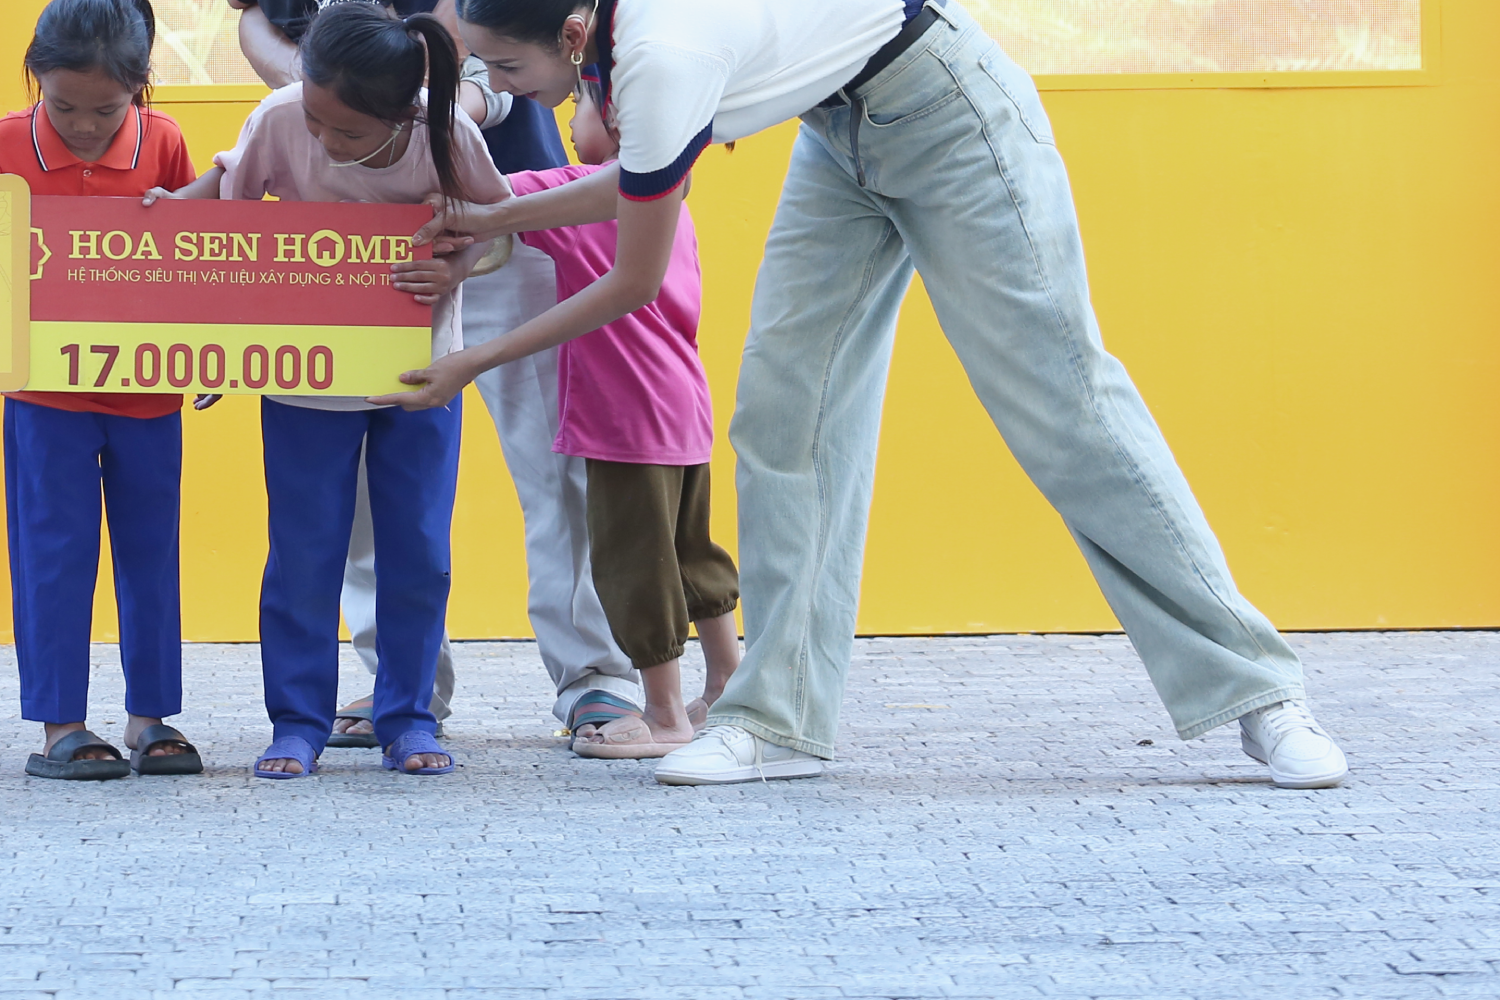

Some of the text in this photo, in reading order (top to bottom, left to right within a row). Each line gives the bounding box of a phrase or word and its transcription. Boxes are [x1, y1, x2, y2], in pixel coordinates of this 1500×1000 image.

[68, 229, 414, 267] HOA SEN HOME
[67, 266, 86, 284] HỆ
[89, 265, 141, 283] THỐNG
[144, 267, 173, 283] SIÊU
[176, 270, 197, 286] THỊ
[200, 268, 226, 286] VẬT
[230, 268, 256, 287] LIỆU
[259, 269, 285, 284] XÂY
[289, 271, 331, 287] DỰNG
[334, 272, 345, 285] &
[349, 270, 376, 288] NỘI
[59, 342, 334, 390] 17.000.000
